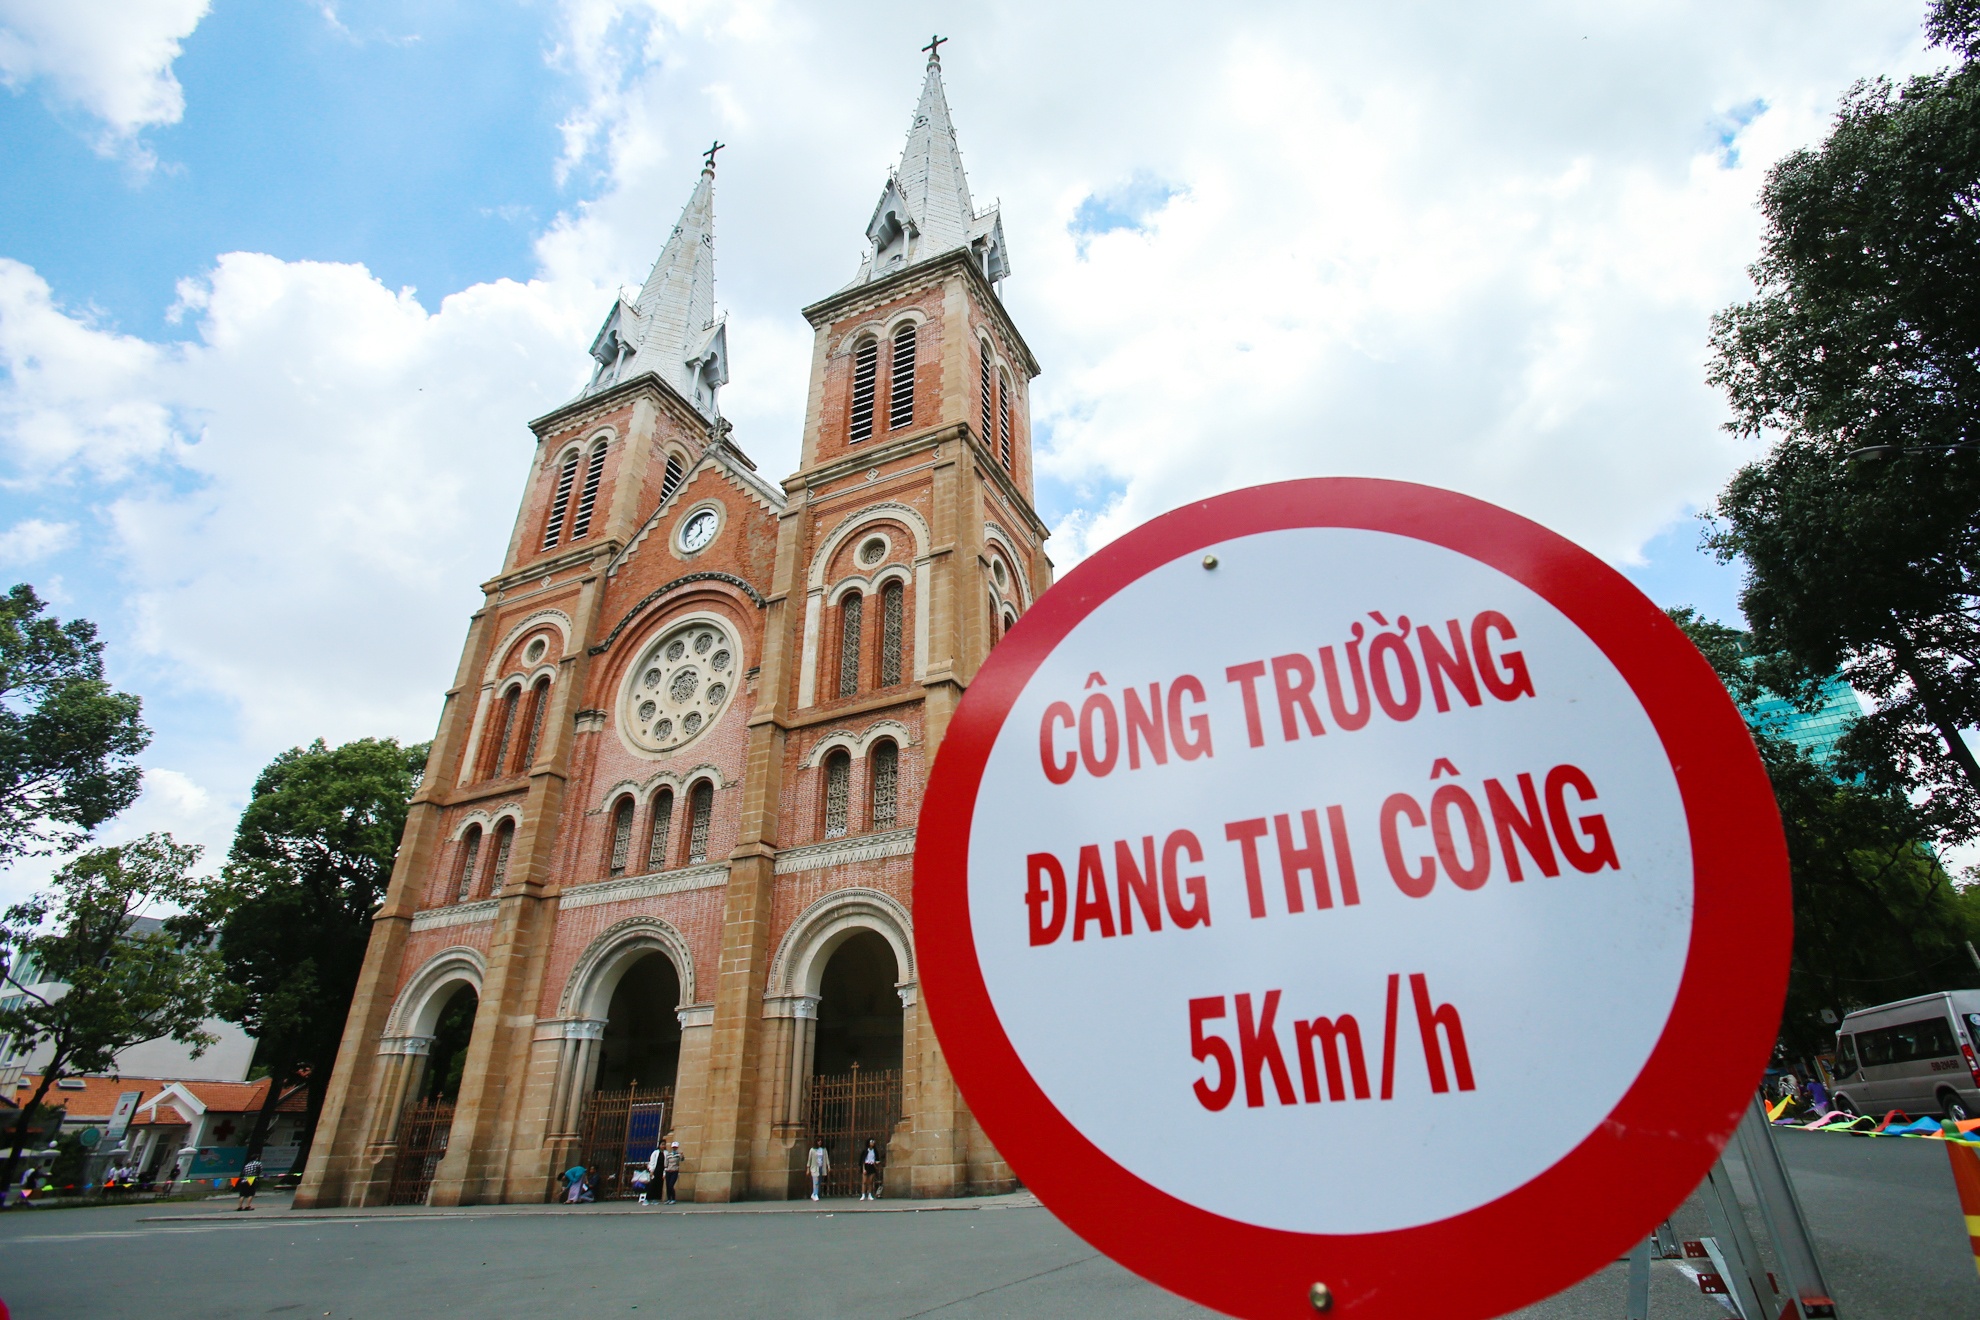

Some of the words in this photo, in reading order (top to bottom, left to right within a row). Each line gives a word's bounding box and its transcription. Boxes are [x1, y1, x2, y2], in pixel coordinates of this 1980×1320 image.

[1039, 671, 1214, 786] CÔNG
[1225, 610, 1536, 749] TRƯỜNG
[1024, 828, 1212, 948] ĐANG
[1224, 804, 1361, 920] THI
[1378, 757, 1622, 900] CÔNG
[1188, 972, 1477, 1113] 5Km/h
